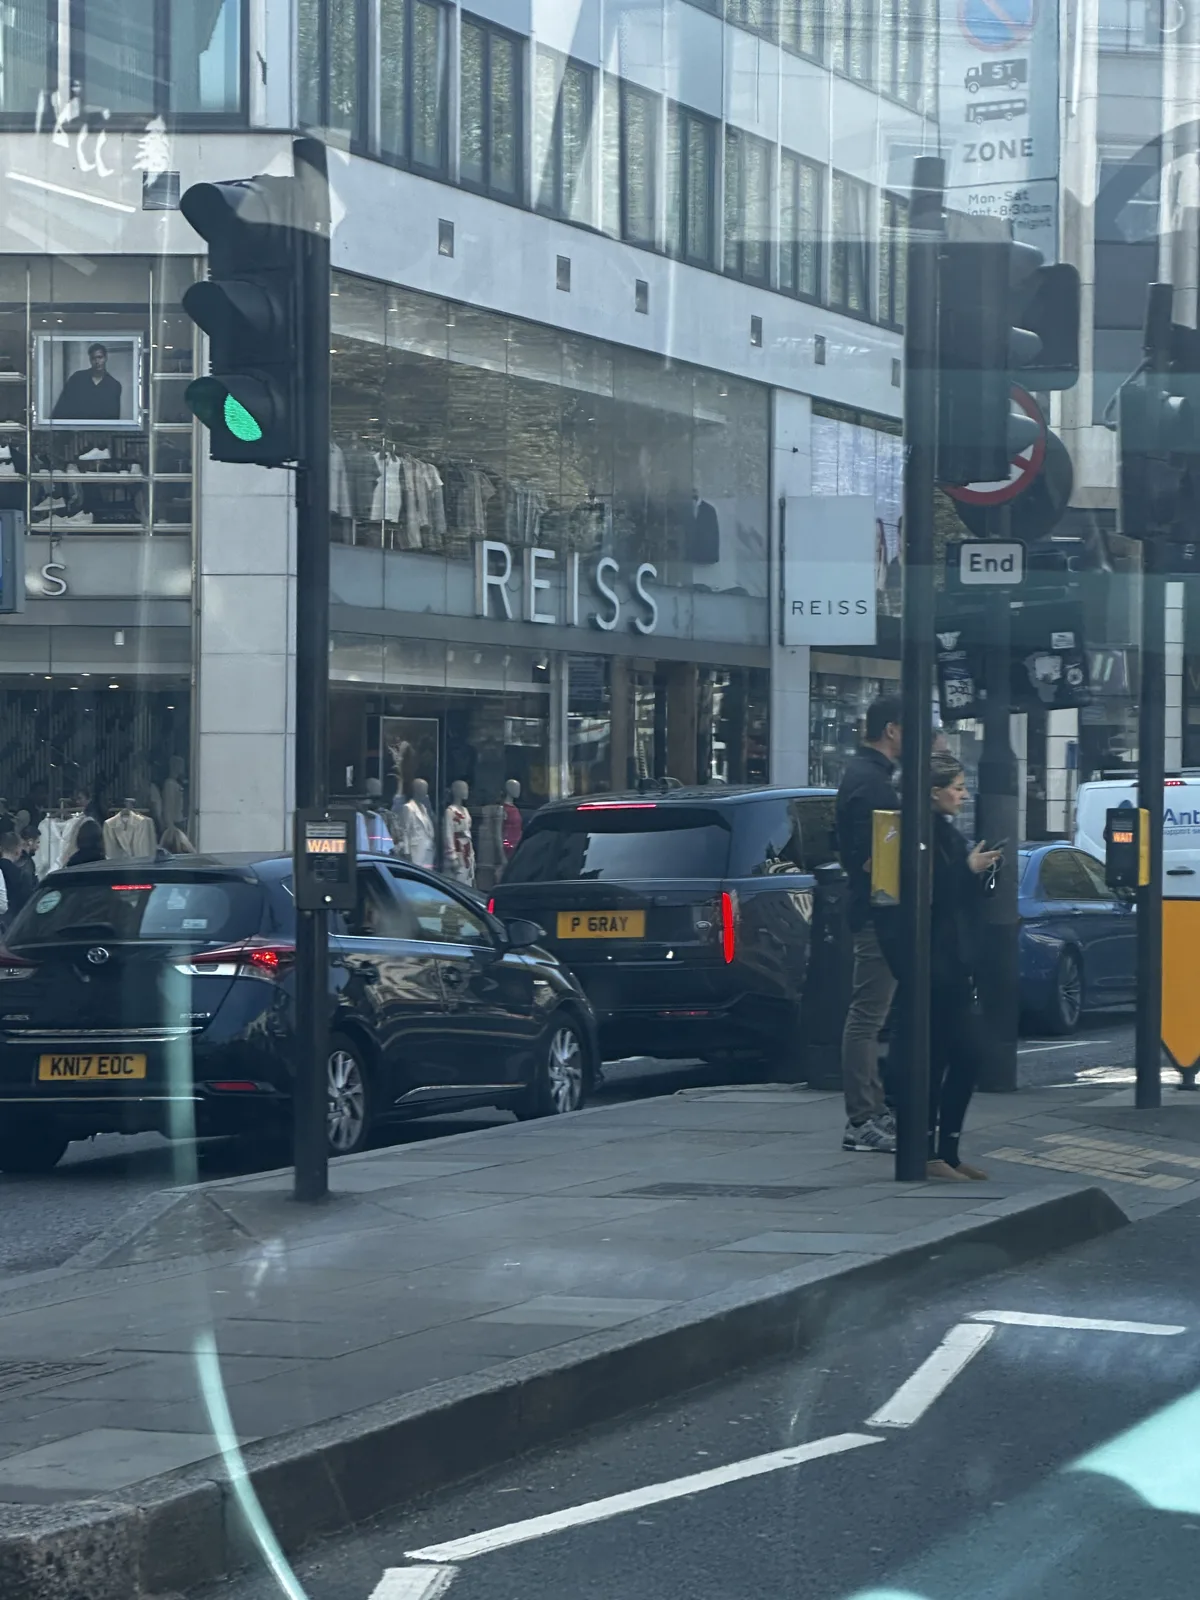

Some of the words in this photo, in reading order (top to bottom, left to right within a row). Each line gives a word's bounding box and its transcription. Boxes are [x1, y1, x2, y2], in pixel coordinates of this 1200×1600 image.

[963, 138, 1034, 163] ZONE
[969, 553, 1014, 572] End
[475, 539, 658, 634] REISS
[792, 600, 867, 615] REISS
[1112, 832, 1133, 843] WAIT
[308, 840, 346, 853] WAIT
[571, 917, 581, 932] P
